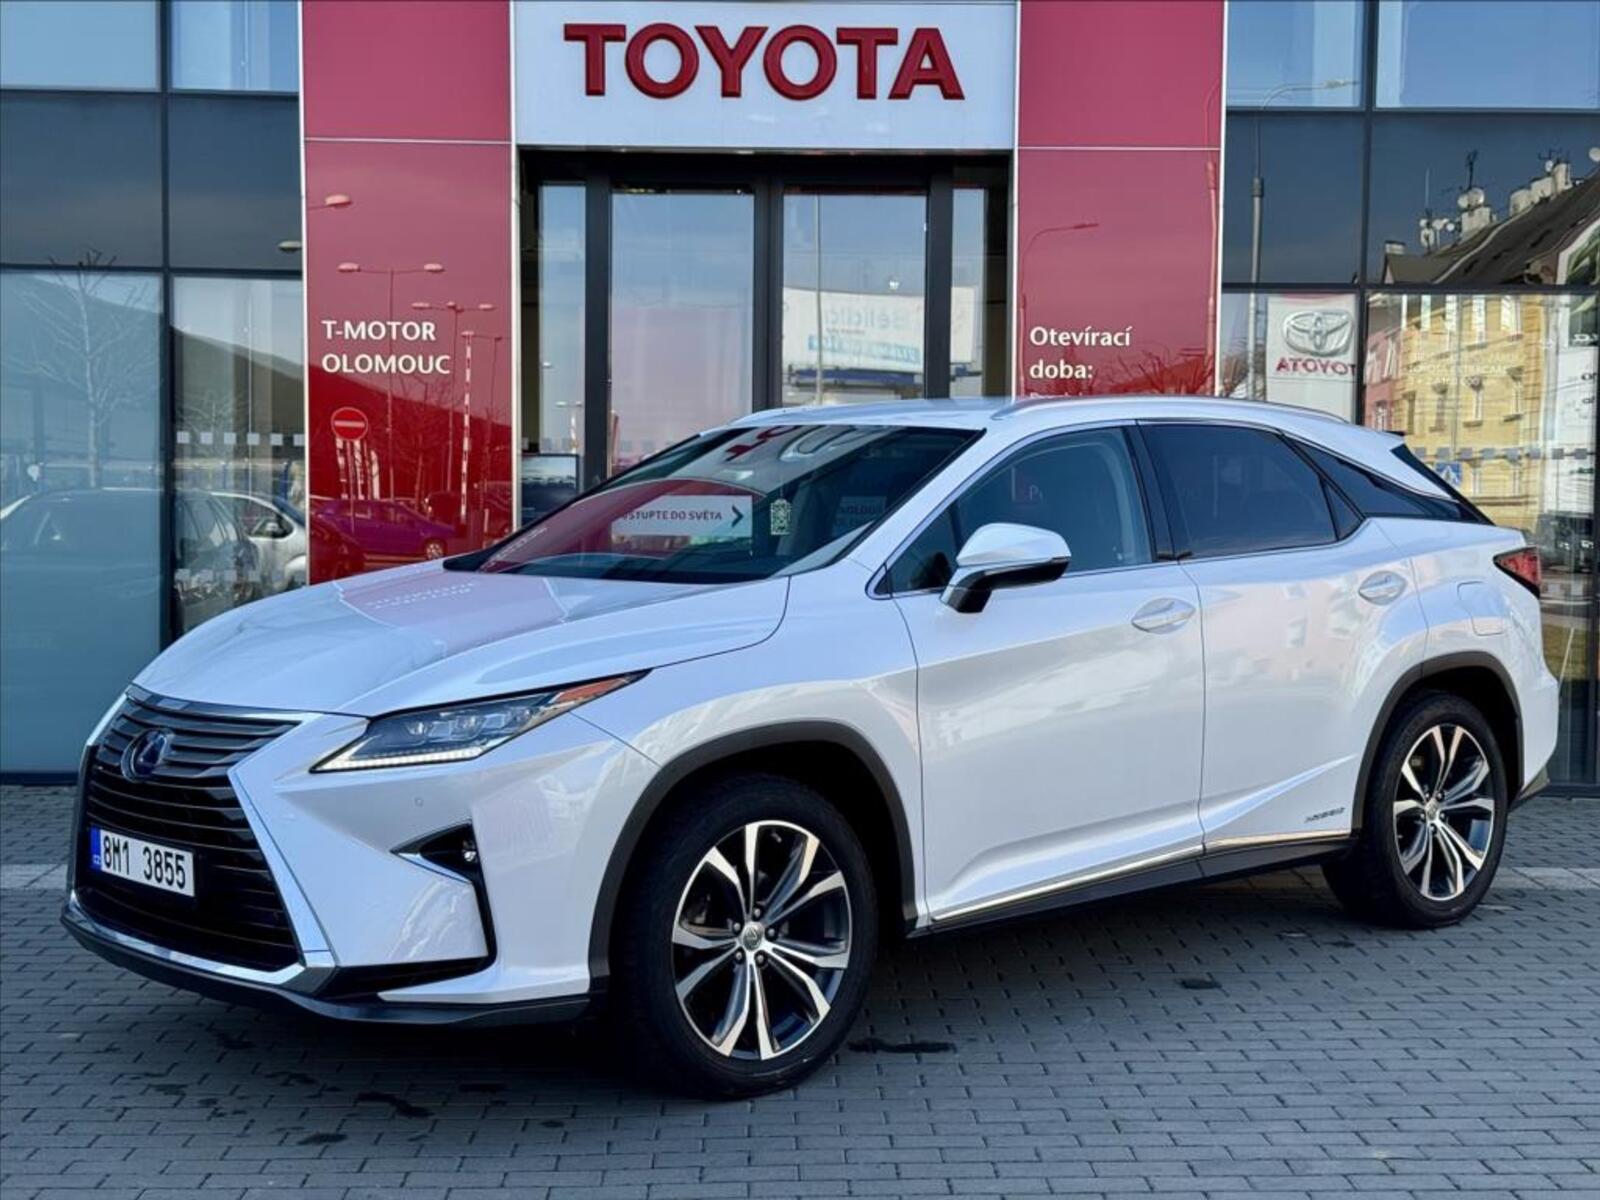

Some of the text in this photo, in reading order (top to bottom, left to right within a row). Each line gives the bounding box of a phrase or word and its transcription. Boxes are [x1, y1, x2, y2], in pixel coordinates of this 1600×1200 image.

[564, 23, 965, 100] TOYOTA
[321, 320, 436, 340] T-MOTOR
[1029, 326, 1132, 346] Otevírací
[321, 353, 451, 374] OLOMOUC
[1029, 358, 1093, 379] doba:
[671, 510, 687, 520] DO
[103, 835, 187, 890] 8M1 3855
